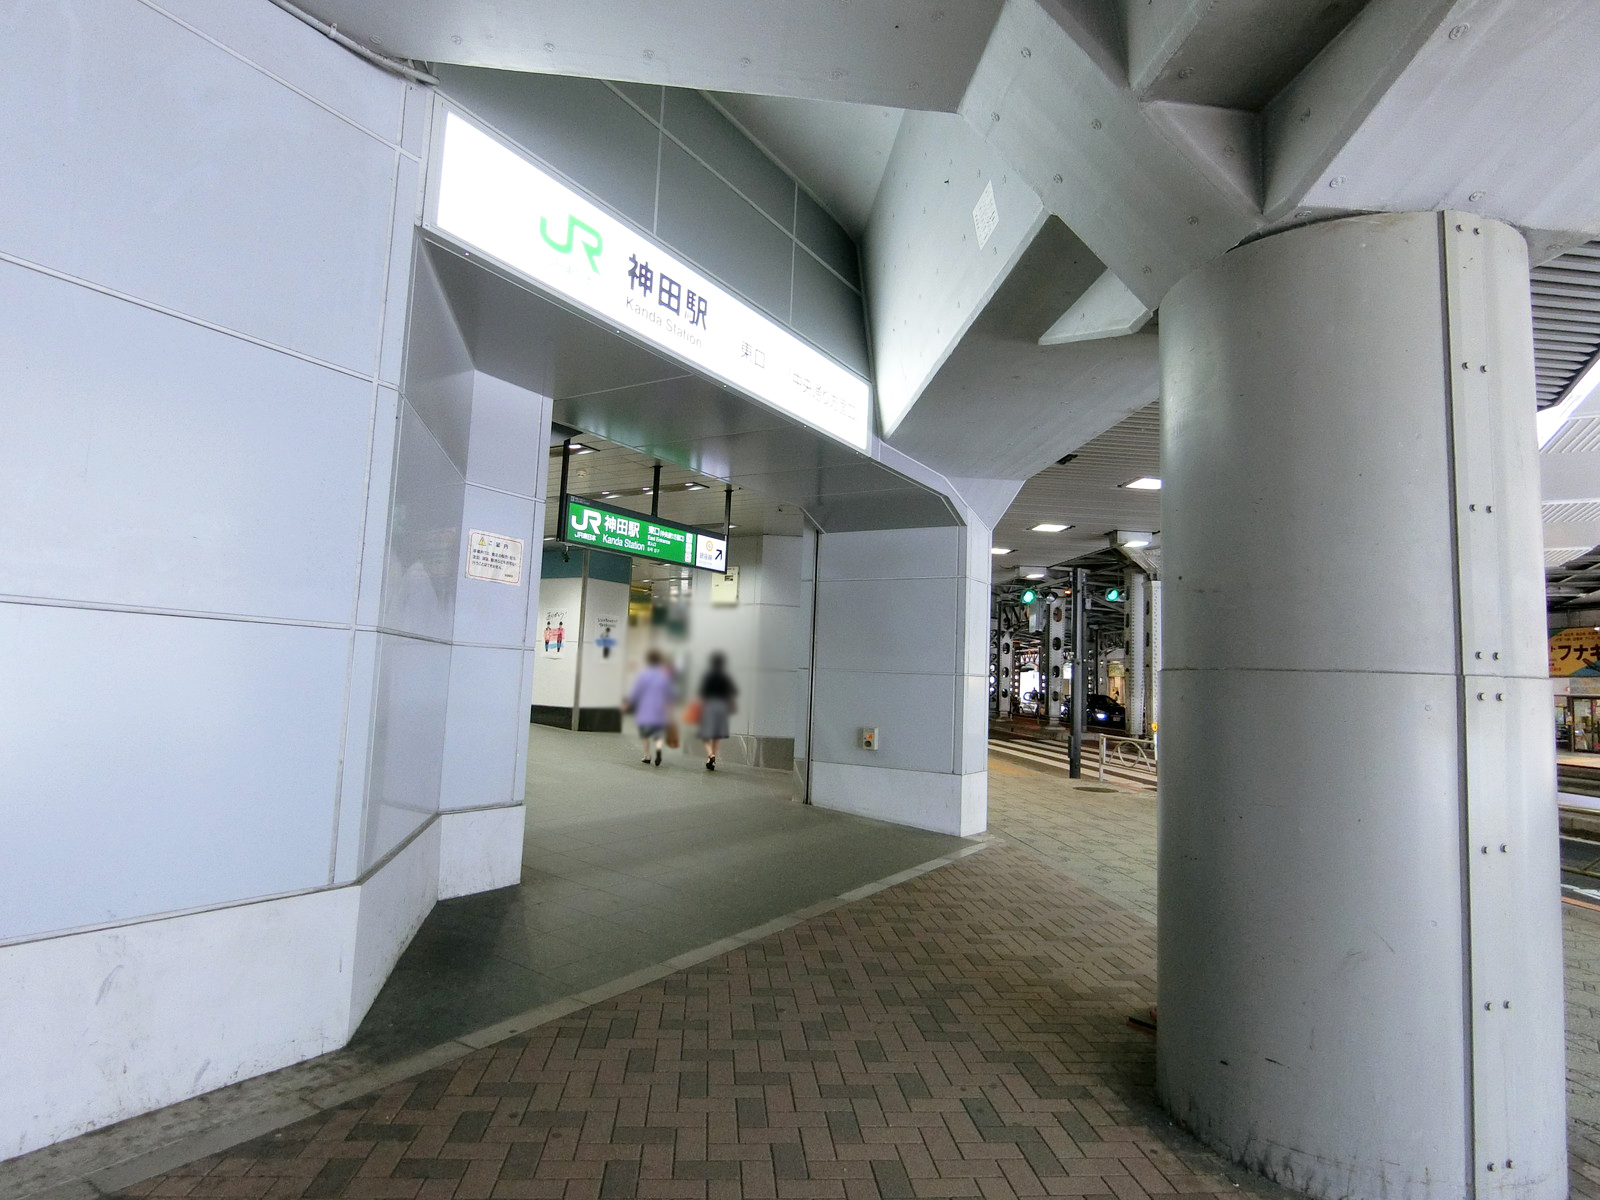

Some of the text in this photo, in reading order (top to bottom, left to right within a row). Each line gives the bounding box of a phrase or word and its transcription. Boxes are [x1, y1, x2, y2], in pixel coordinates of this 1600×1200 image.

[540, 213, 603, 275] JR
[627, 253, 707, 330] 神田駅
[625, 296, 702, 348] Kanda Station
[740, 340, 766, 368] 東口
[571, 509, 601, 534] JR
[604, 514, 640, 538] 神田駅
[574, 531, 597, 542] JR東日本
[602, 533, 645, 551] Kanda Station
